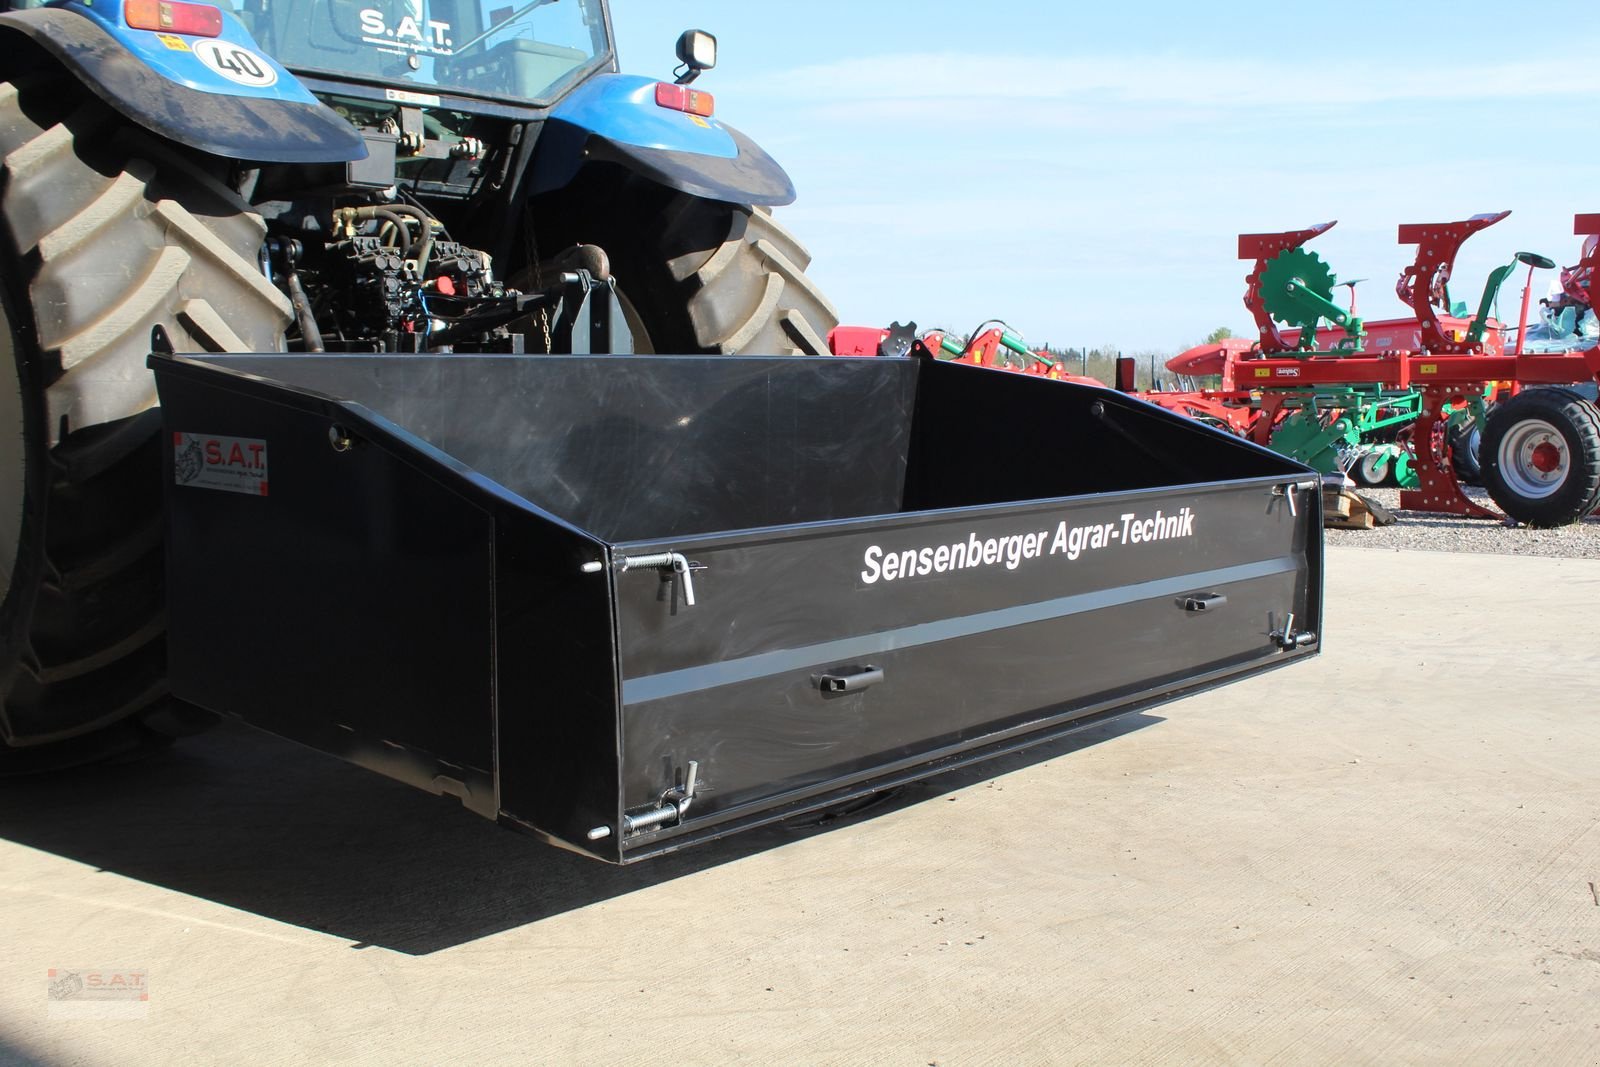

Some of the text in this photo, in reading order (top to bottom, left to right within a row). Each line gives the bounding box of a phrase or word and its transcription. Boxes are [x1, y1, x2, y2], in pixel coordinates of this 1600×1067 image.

[360, 9, 453, 46] S.A.T.
[212, 47, 265, 78] 40
[206, 440, 265, 469] S.A.T.
[861, 508, 1195, 584] Sensenberger Agrar-Technik
